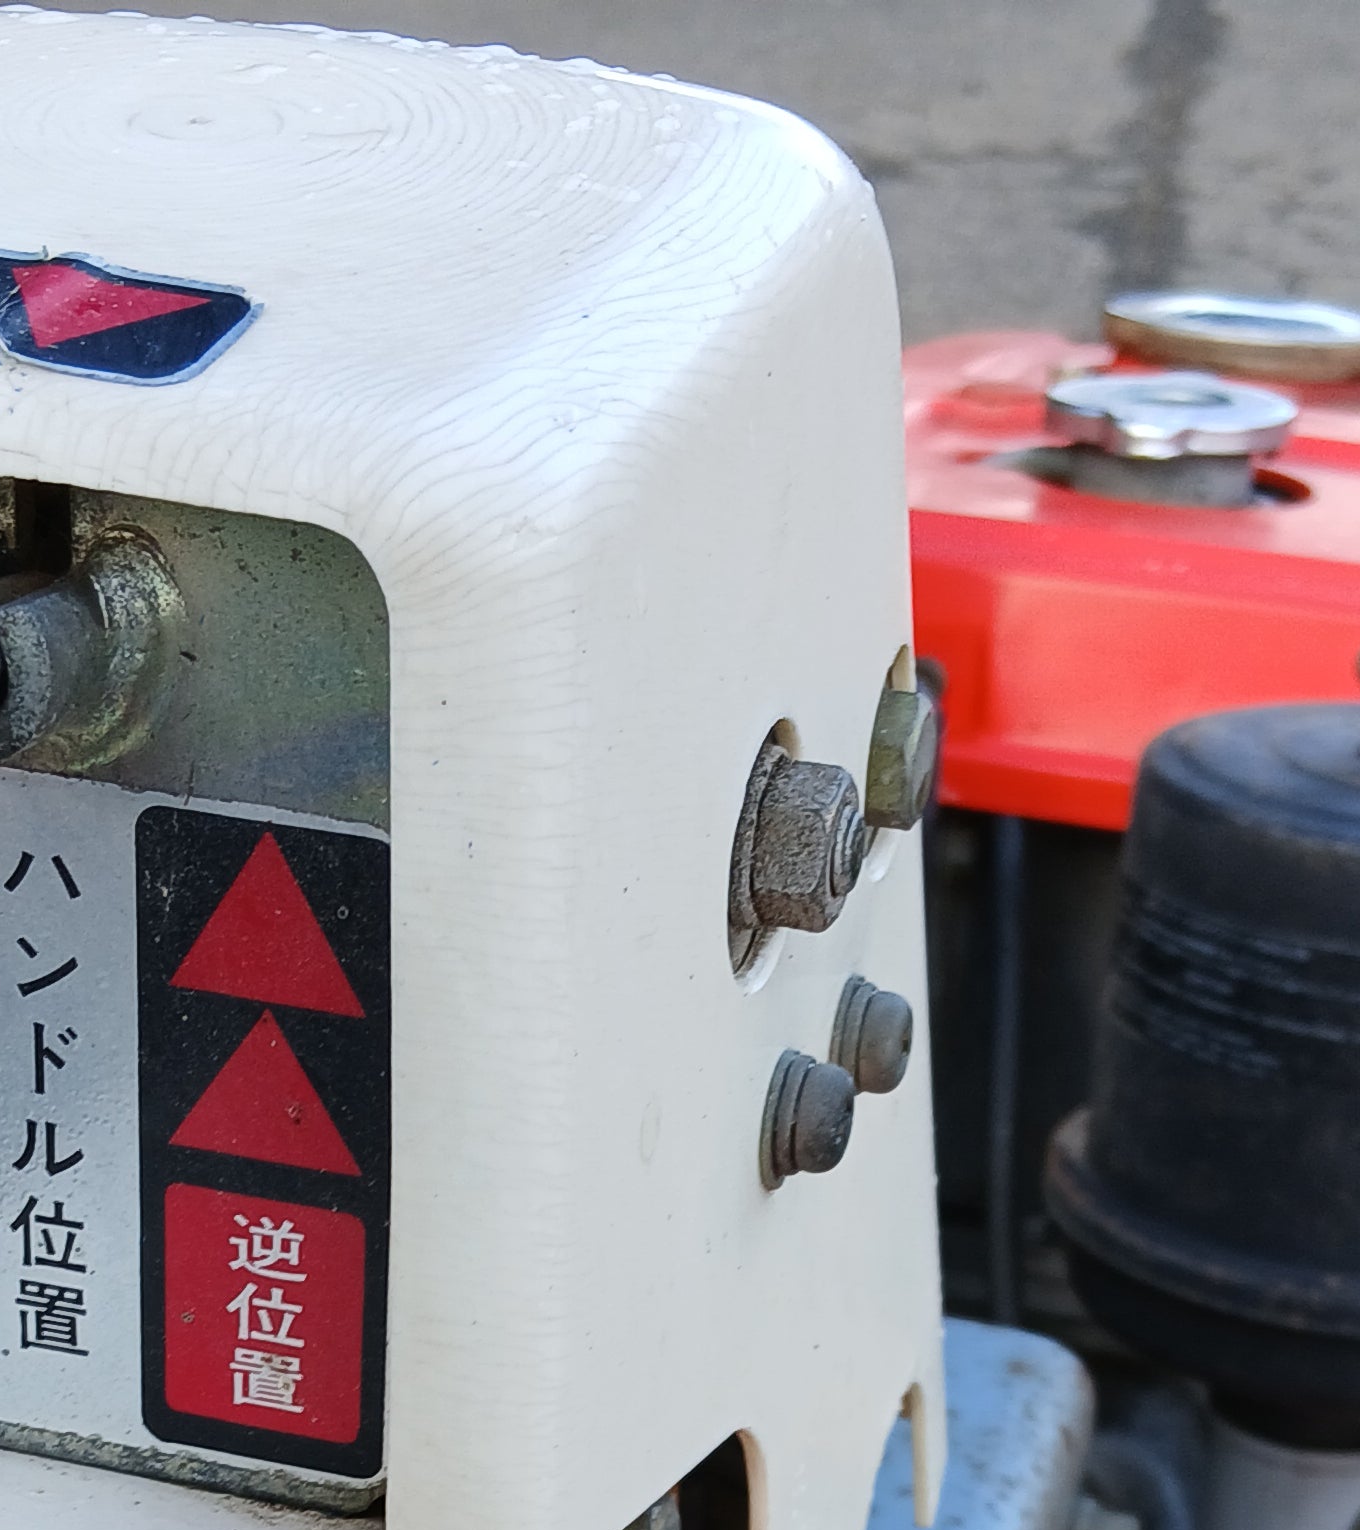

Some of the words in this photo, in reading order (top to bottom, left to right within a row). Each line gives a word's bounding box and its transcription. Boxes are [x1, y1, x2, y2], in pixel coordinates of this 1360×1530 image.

[3, 850, 90, 1358] ハンドル位置
[225, 1213, 307, 1415] 逆位置
